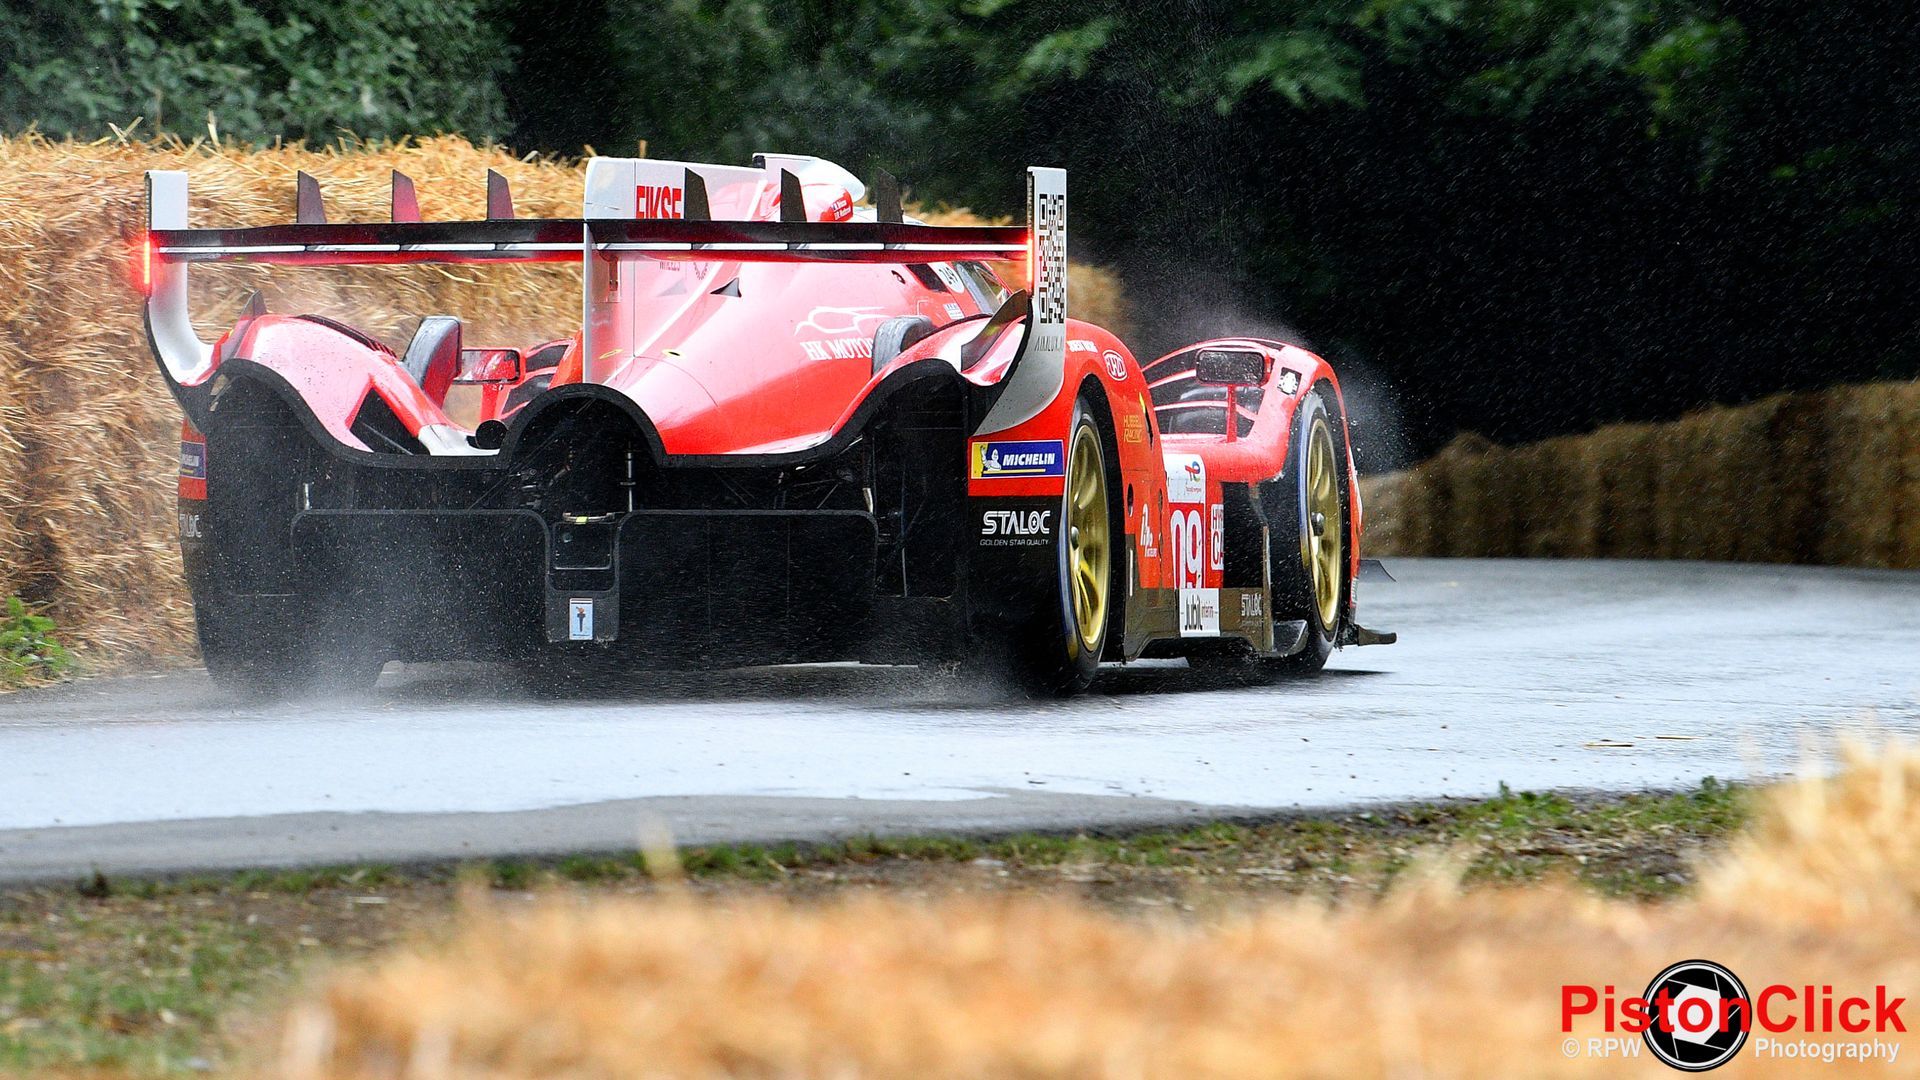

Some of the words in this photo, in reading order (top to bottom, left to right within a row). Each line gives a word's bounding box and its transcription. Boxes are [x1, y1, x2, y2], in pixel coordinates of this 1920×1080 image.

[800, 340, 832, 361] HK
[825, 337, 874, 360] MOTO
[1002, 452, 1056, 467] MICHELIN
[981, 510, 1051, 535] STALOC
[979, 539, 1008, 547] GOLDEN
[1009, 539, 1026, 547] STAR
